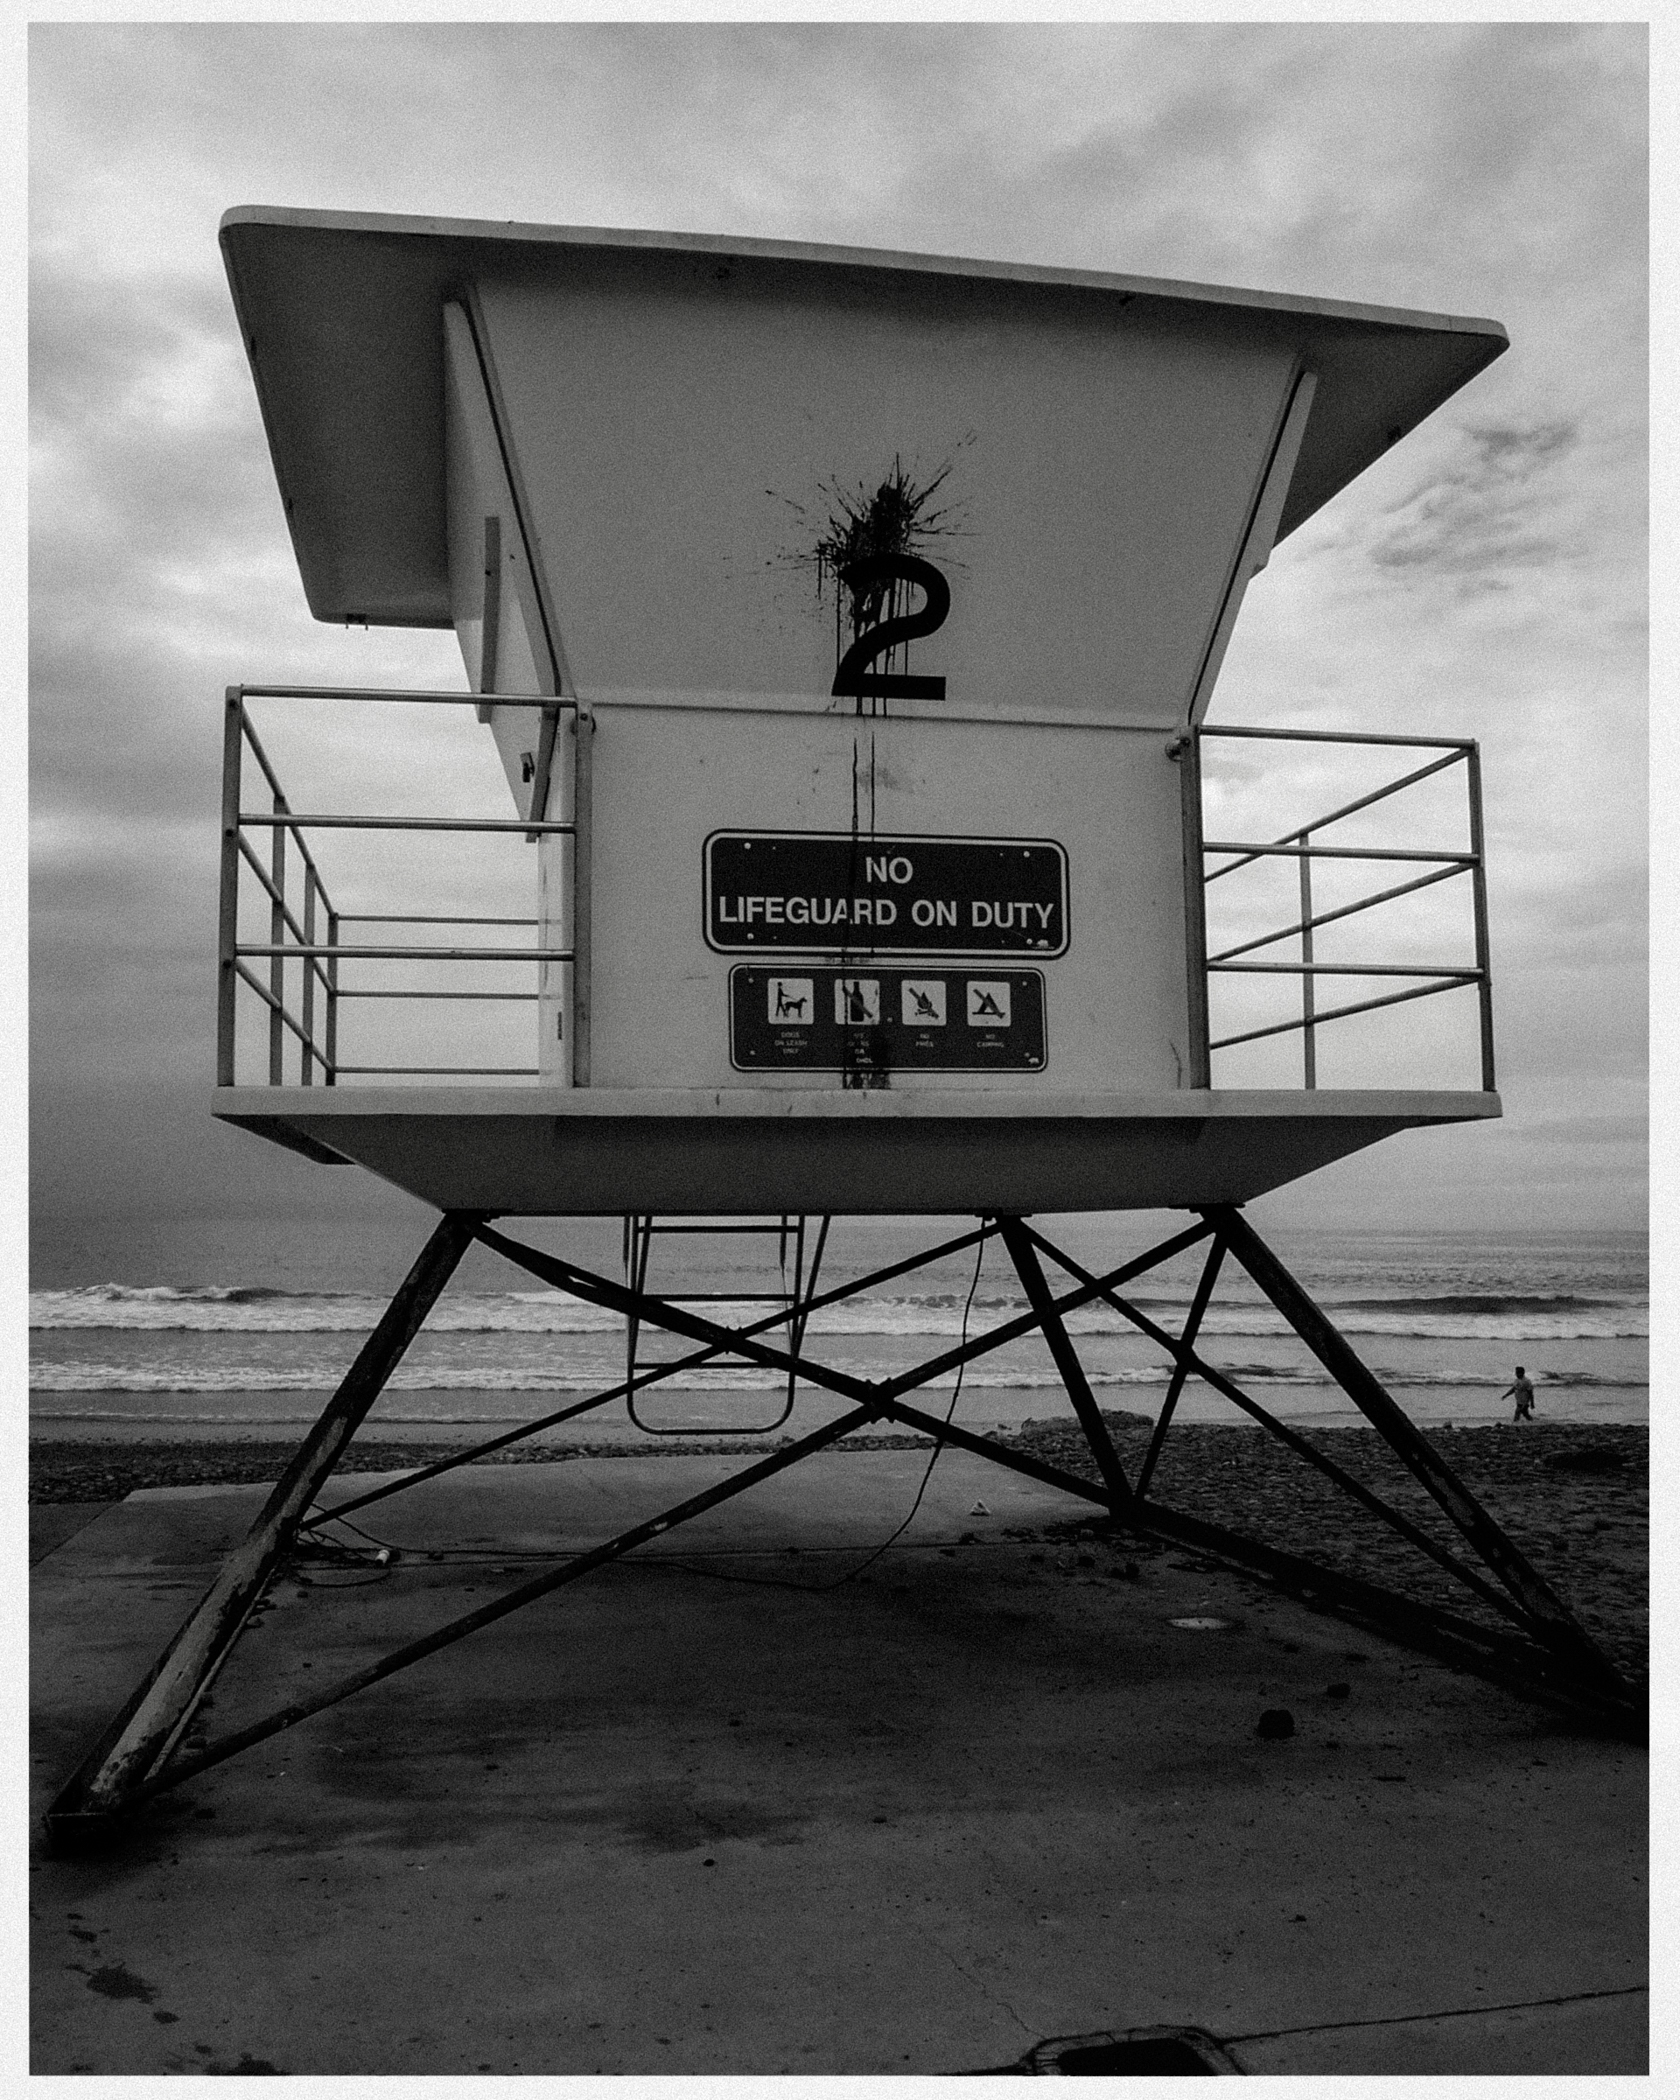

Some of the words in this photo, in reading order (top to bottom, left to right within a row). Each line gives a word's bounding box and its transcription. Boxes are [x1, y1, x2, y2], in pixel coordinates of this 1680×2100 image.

[831, 552, 950, 701] 2
[865, 856, 914, 885] NO
[718, 895, 898, 926] LIFEGUARD
[911, 898, 957, 928] ON
[971, 900, 1054, 930] DUTY
